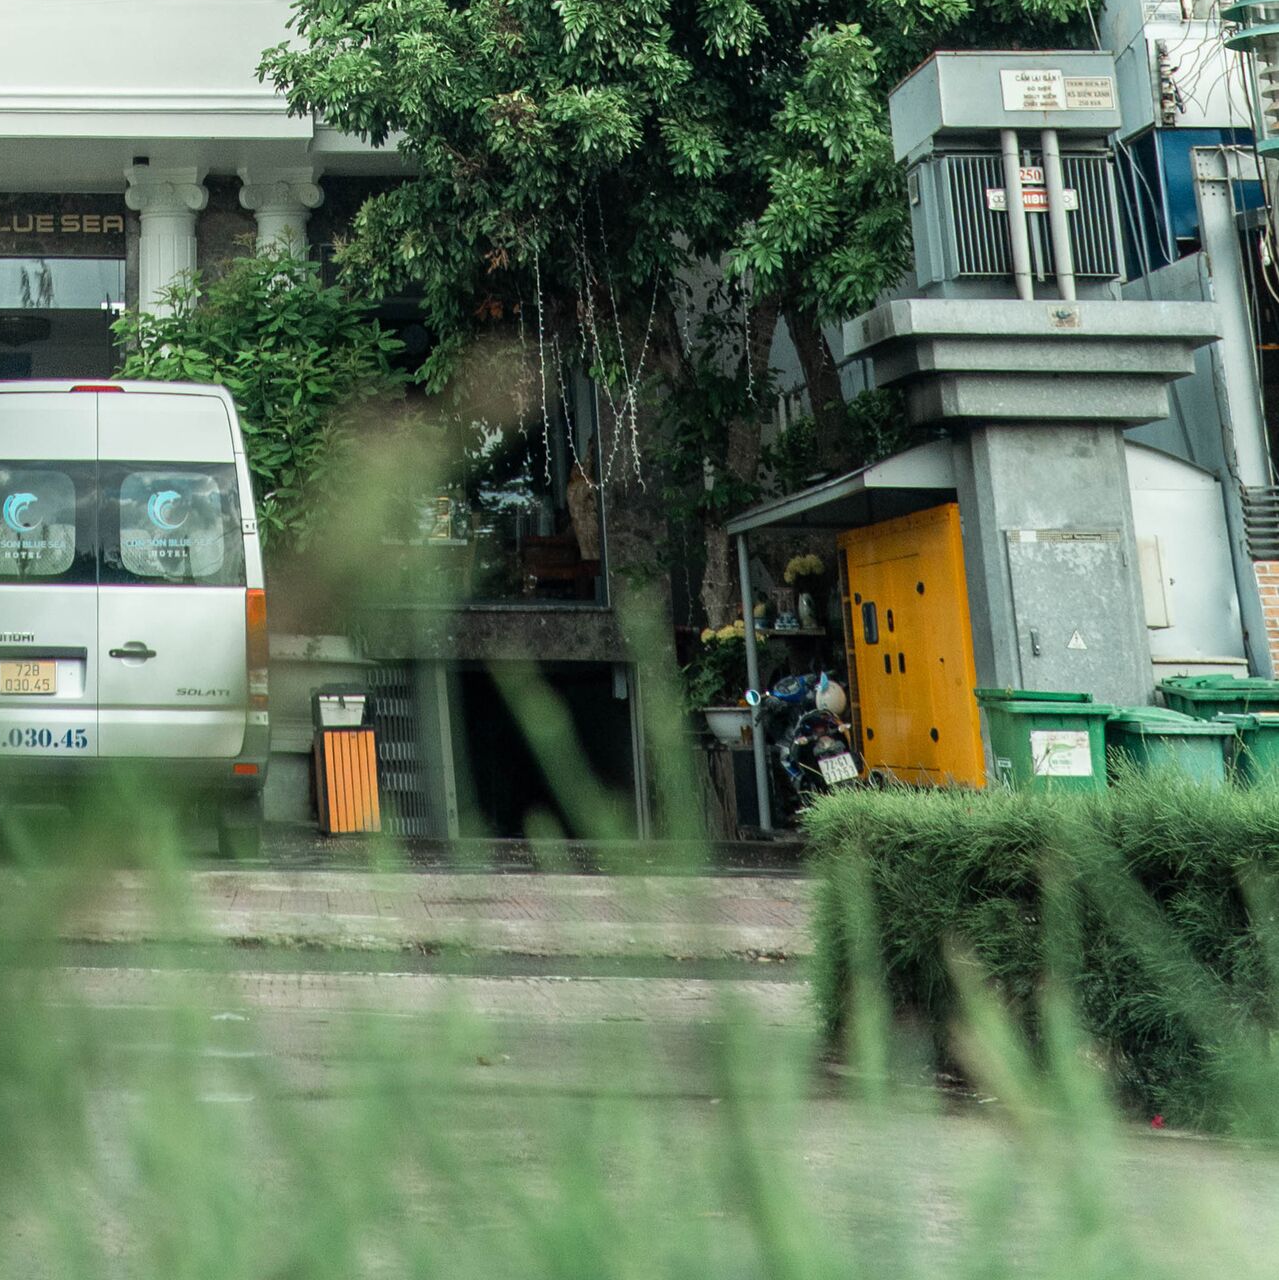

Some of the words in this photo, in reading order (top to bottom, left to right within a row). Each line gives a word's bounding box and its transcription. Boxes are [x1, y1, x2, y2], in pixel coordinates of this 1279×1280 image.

[1020, 169, 1041, 181] 250
[61, 214, 124, 233] SEA
[1, 540, 21, 549] SON
[4, 551, 42, 559] HOTEL
[151, 549, 188, 557] HOTEL
[15, 663, 40, 677] 72B
[5, 679, 50, 691] 030.45
